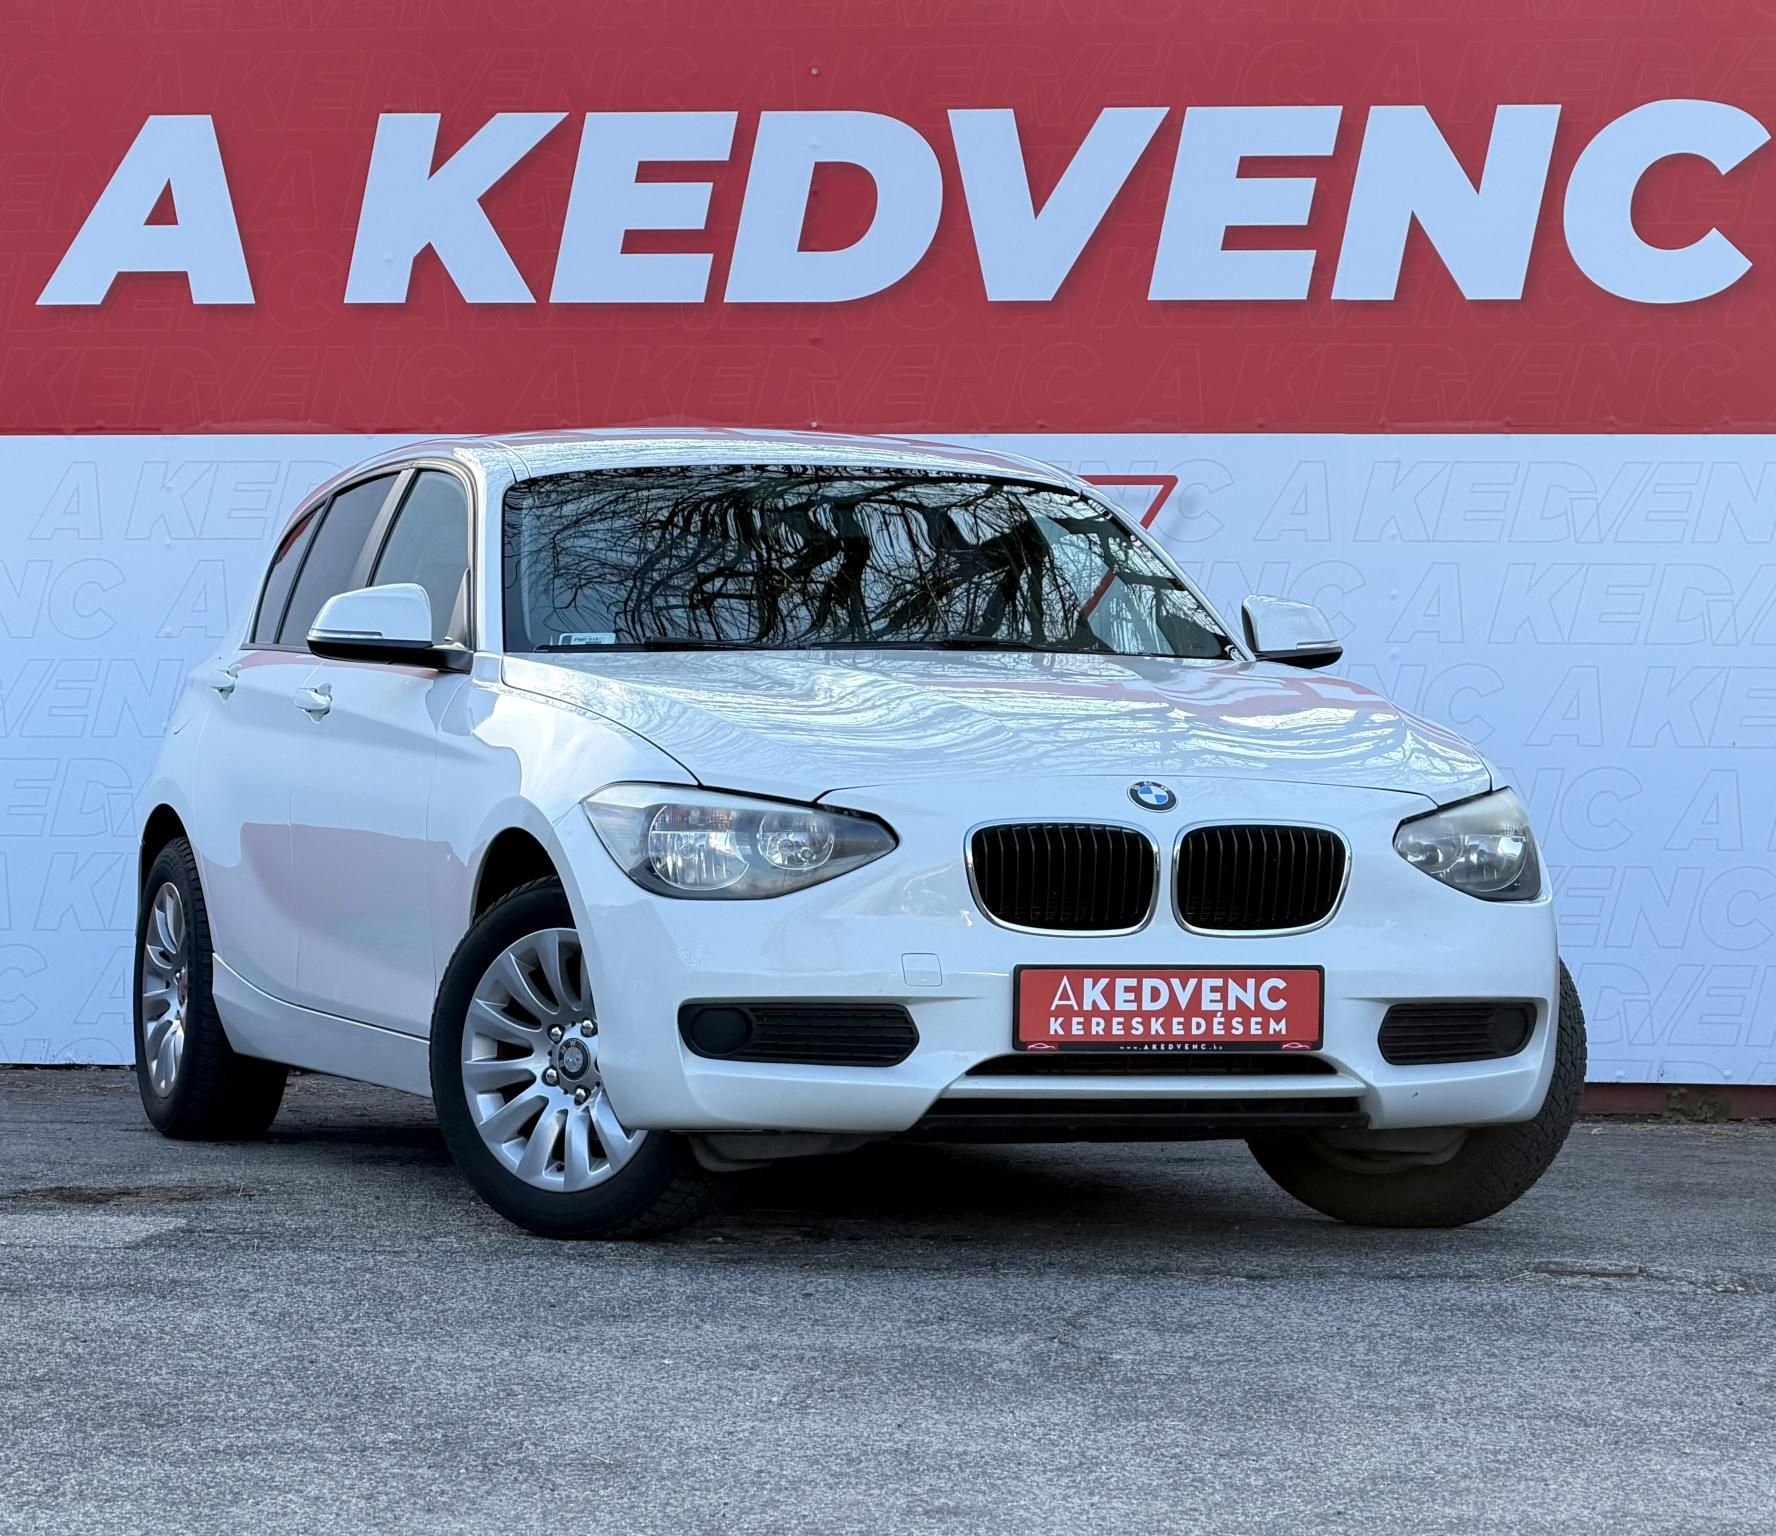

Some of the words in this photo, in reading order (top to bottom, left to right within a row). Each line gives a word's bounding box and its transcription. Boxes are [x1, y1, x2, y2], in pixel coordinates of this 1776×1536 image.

[35, 114, 255, 306] A
[344, 97, 1771, 305] KEDVENC
[244, 149, 319, 231] A
[503, 344, 582, 427] A
[602, 342, 1101, 427] KEDVENC
[1127, 342, 1206, 426] A
[1226, 340, 1743, 426] KEDVENC
[30, 460, 104, 542] A
[1252, 460, 1332, 543] A
[154, 559, 230, 640] A
[1384, 562, 1465, 644] A
[1522, 665, 1605, 748] A
[1663, 769, 1745, 852] A
[73, 945, 134, 1025] A
[1049, 1012, 1287, 1036] KERESKEDÉSEM
